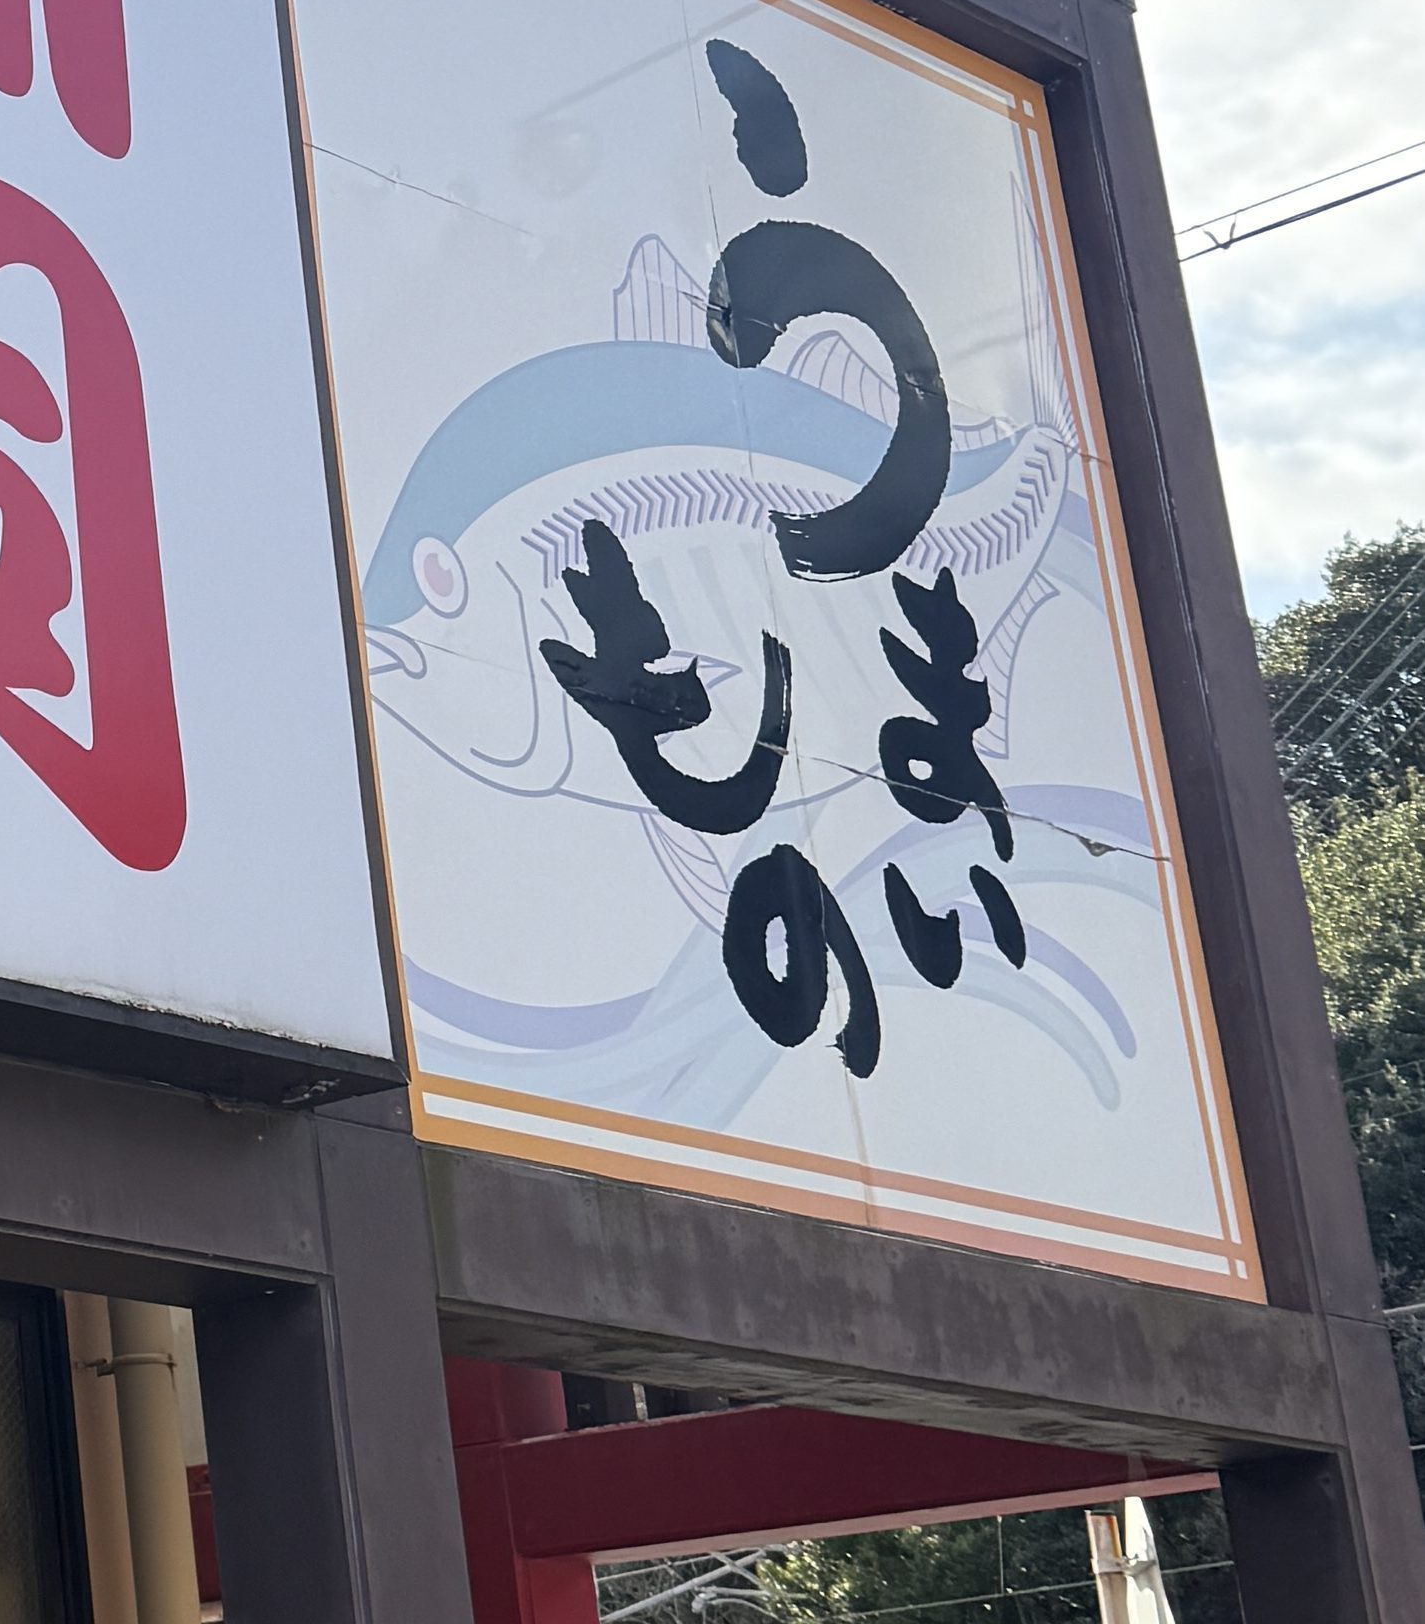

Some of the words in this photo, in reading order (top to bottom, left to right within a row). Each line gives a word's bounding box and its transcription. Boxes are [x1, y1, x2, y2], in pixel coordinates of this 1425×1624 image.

[538, 518, 883, 1080] もの
[705, 38, 1028, 990] うまい
